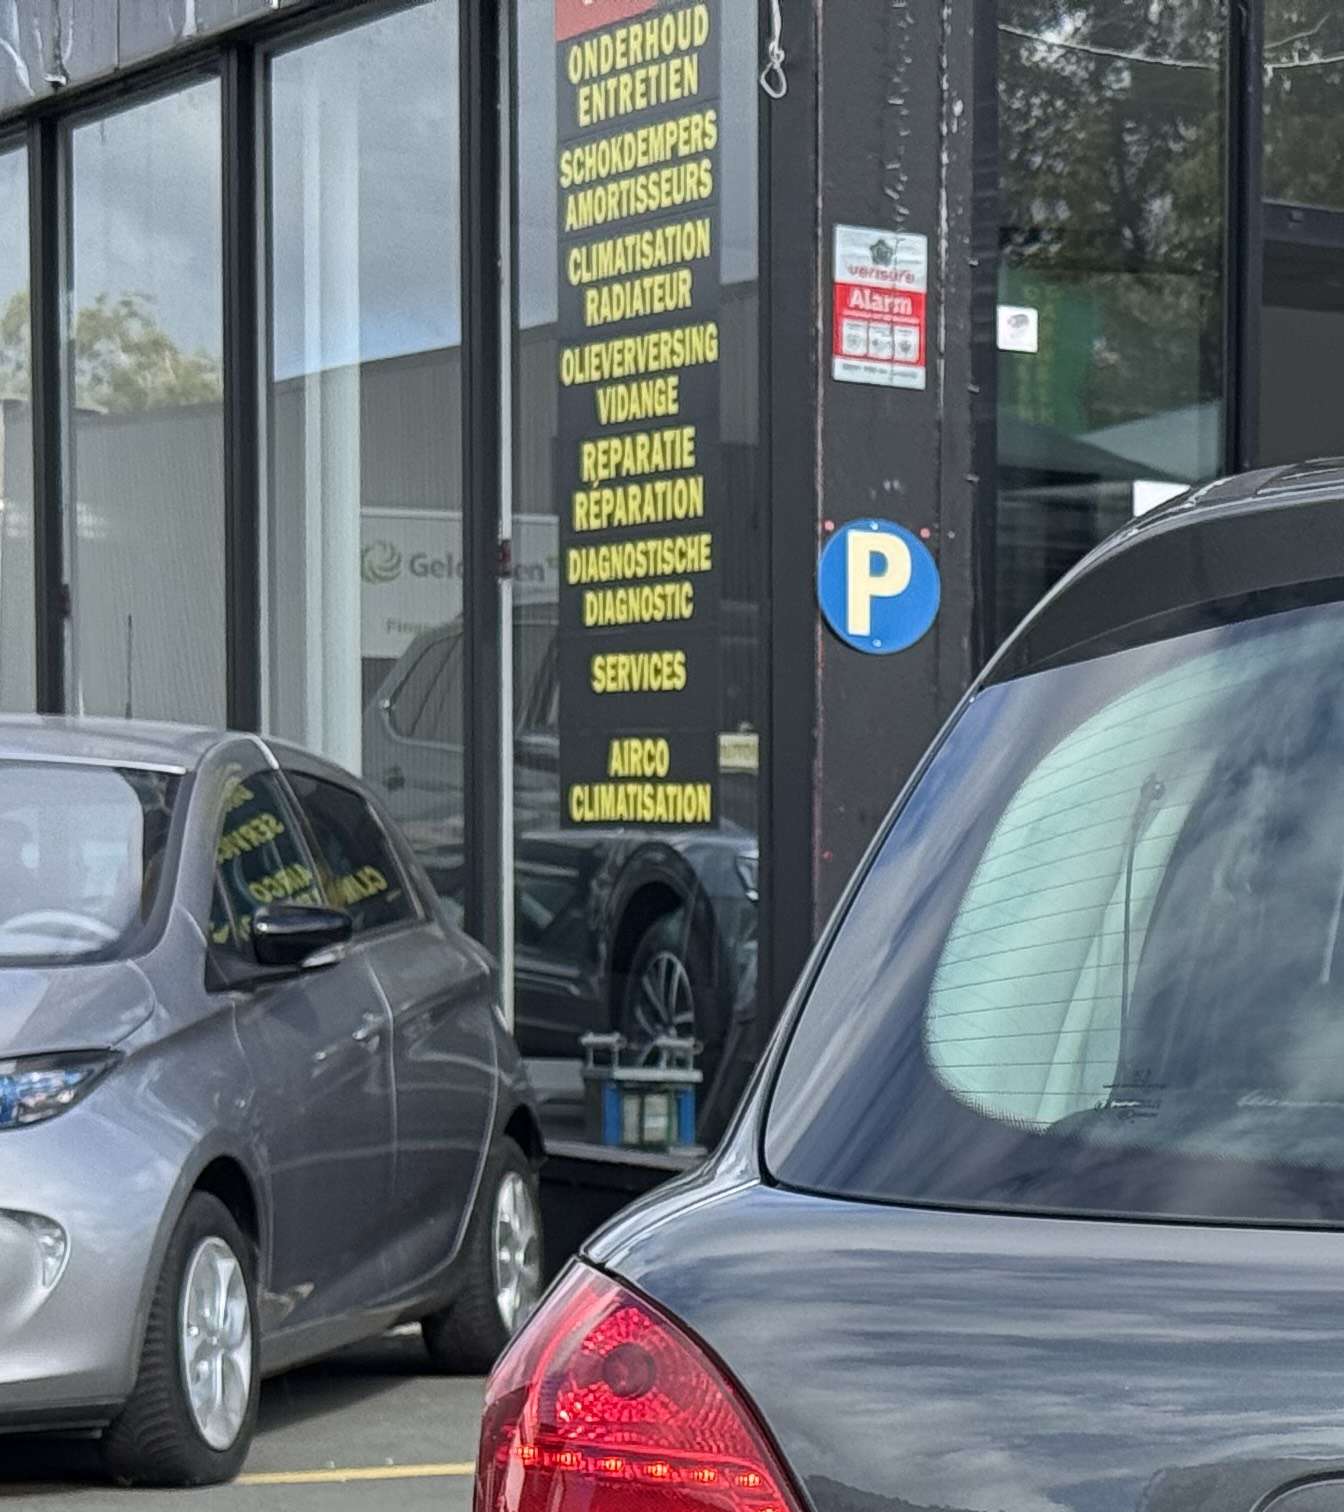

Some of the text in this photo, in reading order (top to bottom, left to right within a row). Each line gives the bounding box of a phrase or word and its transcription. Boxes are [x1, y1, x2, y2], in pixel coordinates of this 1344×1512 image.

[568, 4, 709, 84] ONDERHOUD
[579, 53, 698, 127] ENTRETIEN
[560, 110, 717, 188] SCHOKDEMPERS
[565, 159, 712, 232] AMORTISSEURS
[568, 218, 710, 285] CLIMATISATION
[585, 269, 692, 327] RADIATEUR
[850, 288, 913, 315] Alarm
[561, 322, 718, 386] OLIEVERVERSING
[596, 374, 679, 425] VIDANGE
[582, 426, 696, 482] REPARATIE
[574, 475, 704, 532] RÉPARATION
[568, 533, 712, 585] DIAGNOSTISCHE
[847, 529, 912, 636] P
[585, 581, 694, 627] DIAGNOSTIC
[591, 651, 686, 693] SERVICES
[608, 738, 670, 778] AIRCO
[569, 783, 712, 823] CLIMATISATION
